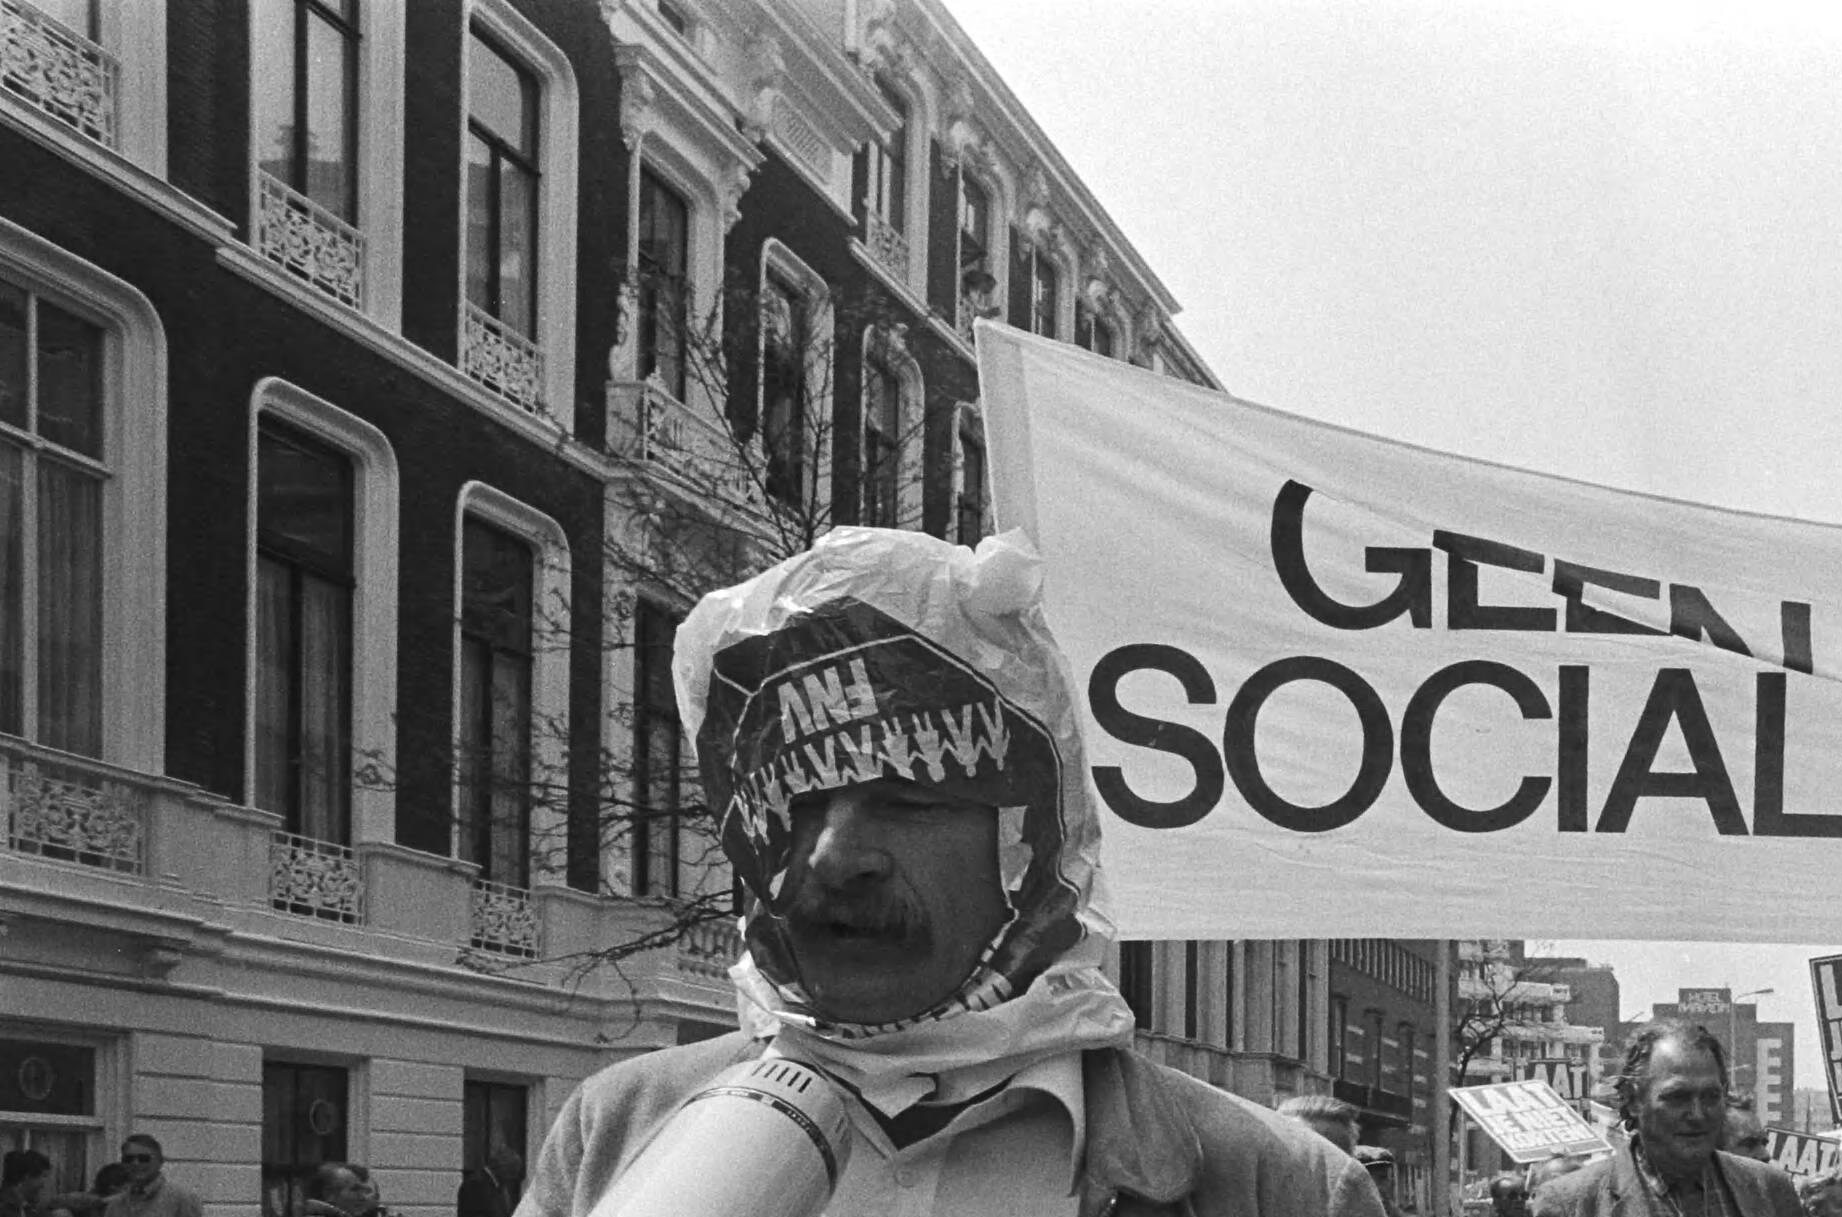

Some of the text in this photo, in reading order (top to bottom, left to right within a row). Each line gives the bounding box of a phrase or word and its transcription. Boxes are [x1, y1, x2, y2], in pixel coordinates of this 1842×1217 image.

[1271, 479, 1813, 673] GEEN
[778, 658, 879, 744] FNV
[1457, 1082, 1560, 1117] LAAT
[1484, 1113, 1520, 1136] JE
[1512, 1106, 1578, 1132] NIET
[1502, 1123, 1596, 1150] KORTEN!
